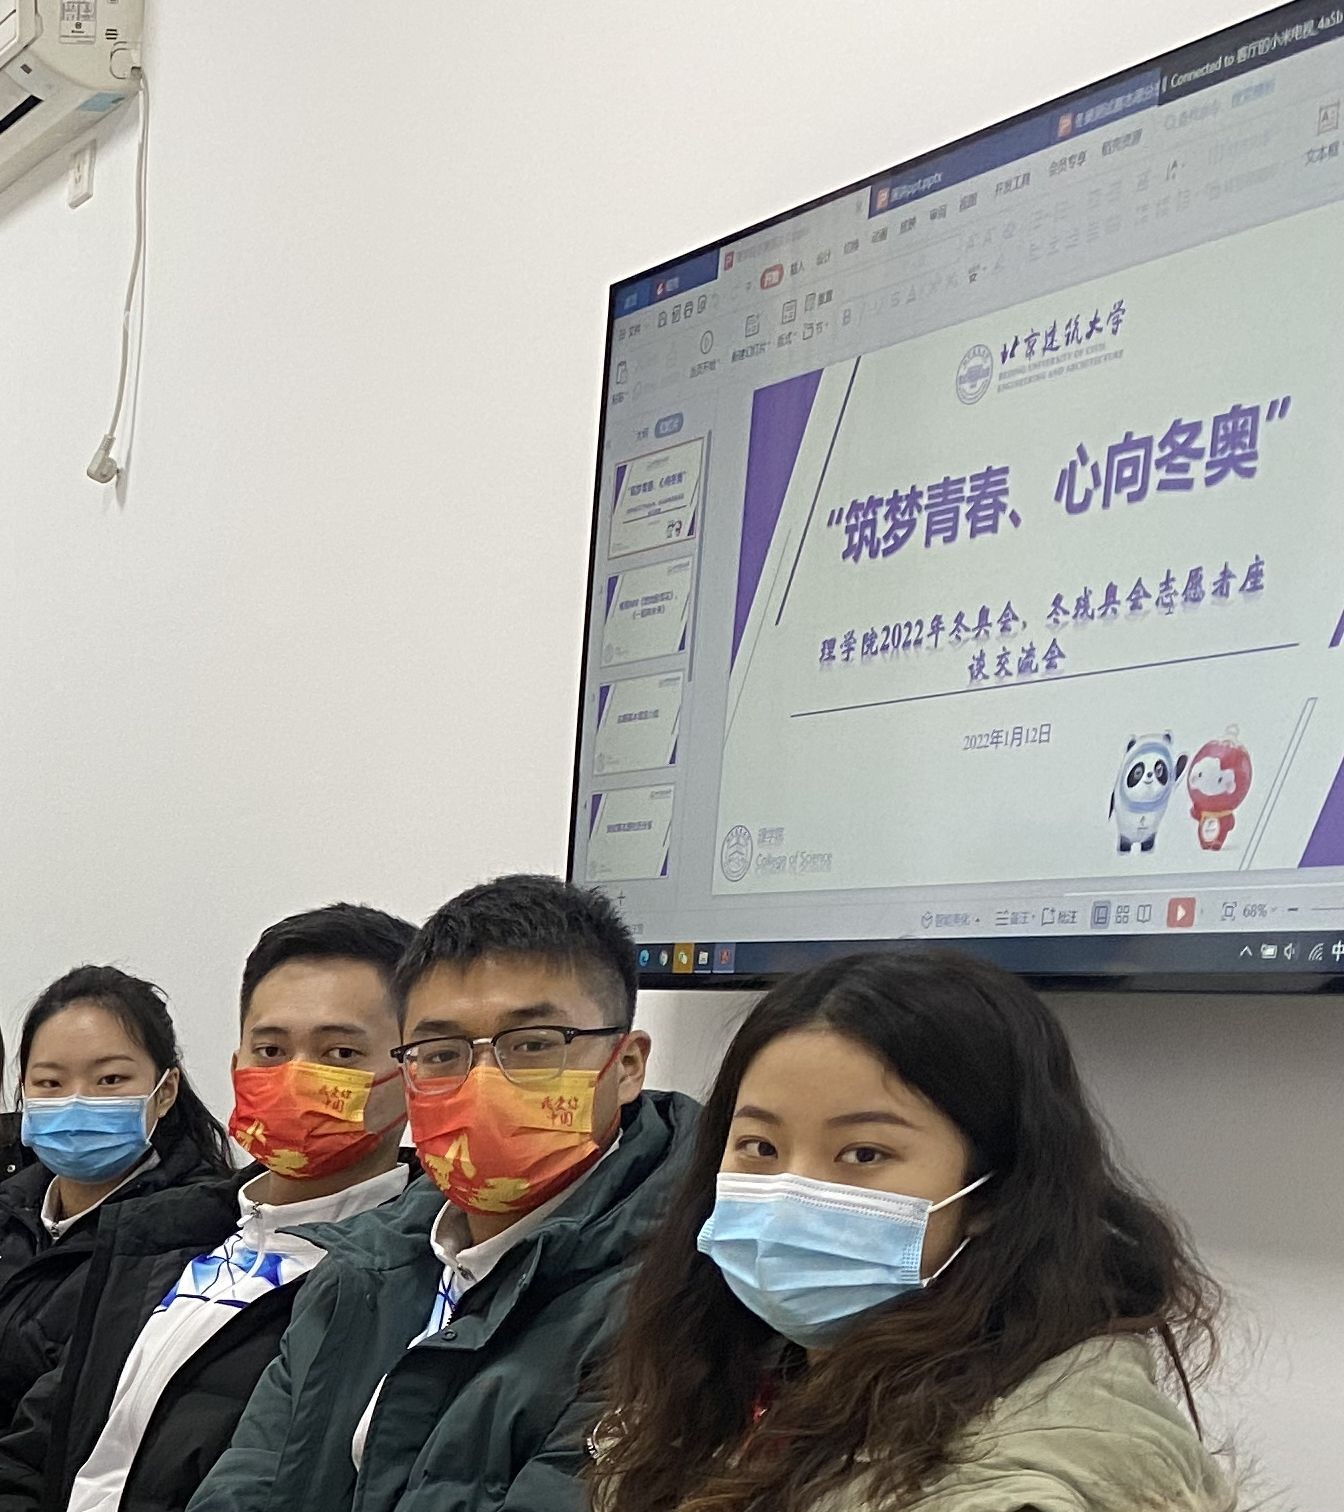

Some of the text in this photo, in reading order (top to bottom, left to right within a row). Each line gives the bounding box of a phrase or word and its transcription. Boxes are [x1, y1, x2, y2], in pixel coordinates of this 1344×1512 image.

[1170, 56, 1222, 88] Connected
[1224, 48, 1235, 69] to
[1000, 299, 1127, 365] 北京建筑大学
[826, 396, 1292, 563] “筑梦青春、心向冬奥”
[818, 555, 1266, 663] 理学院2022年冬奥会，冬残奥会志愿者座
[968, 637, 1067, 682] 谈交流会
[963, 722, 1052, 753] 2022年1月12日
[1242, 903, 1268, 918] 68%
